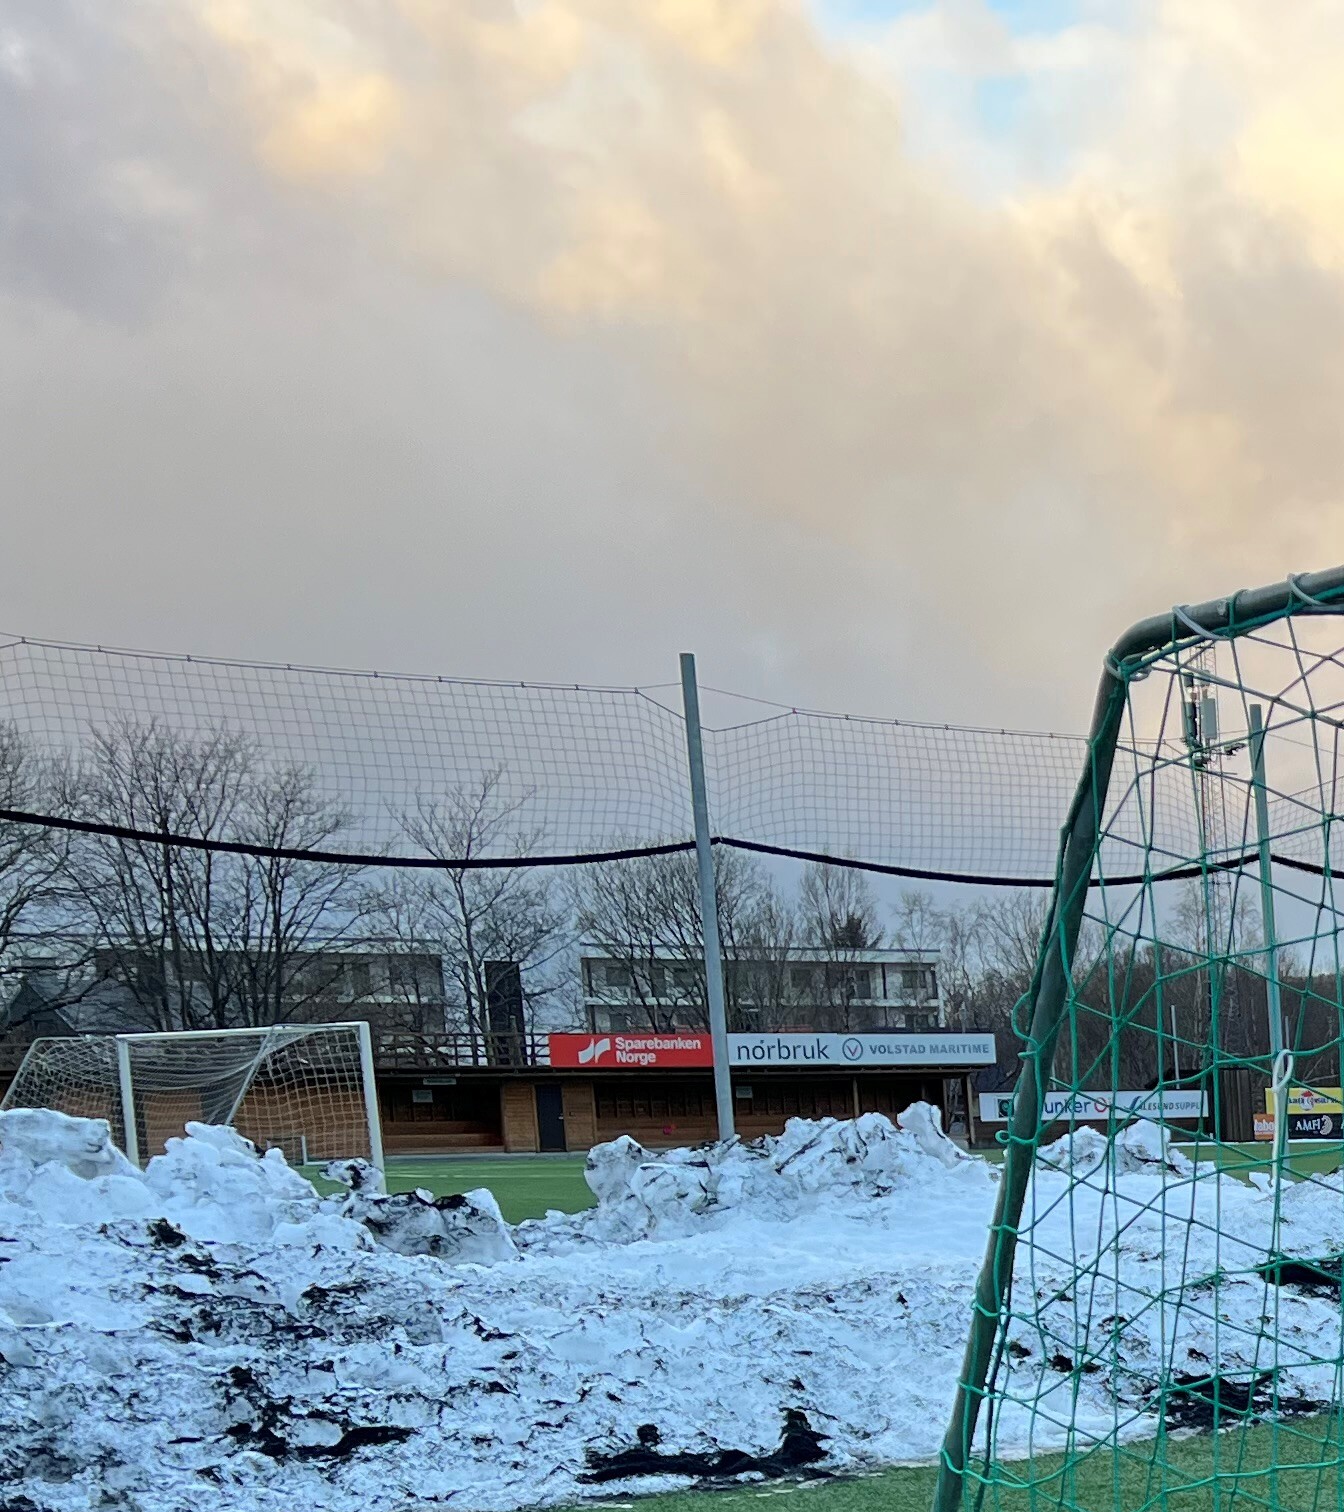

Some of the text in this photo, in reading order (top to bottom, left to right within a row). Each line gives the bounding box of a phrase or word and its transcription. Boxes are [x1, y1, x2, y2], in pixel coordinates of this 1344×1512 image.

[615, 1037, 702, 1051] Sparebanken
[869, 1043, 990, 1055] VOLSTAD MARITIME
[615, 1051, 657, 1065] Norge
[1044, 1097, 1092, 1114] unker
